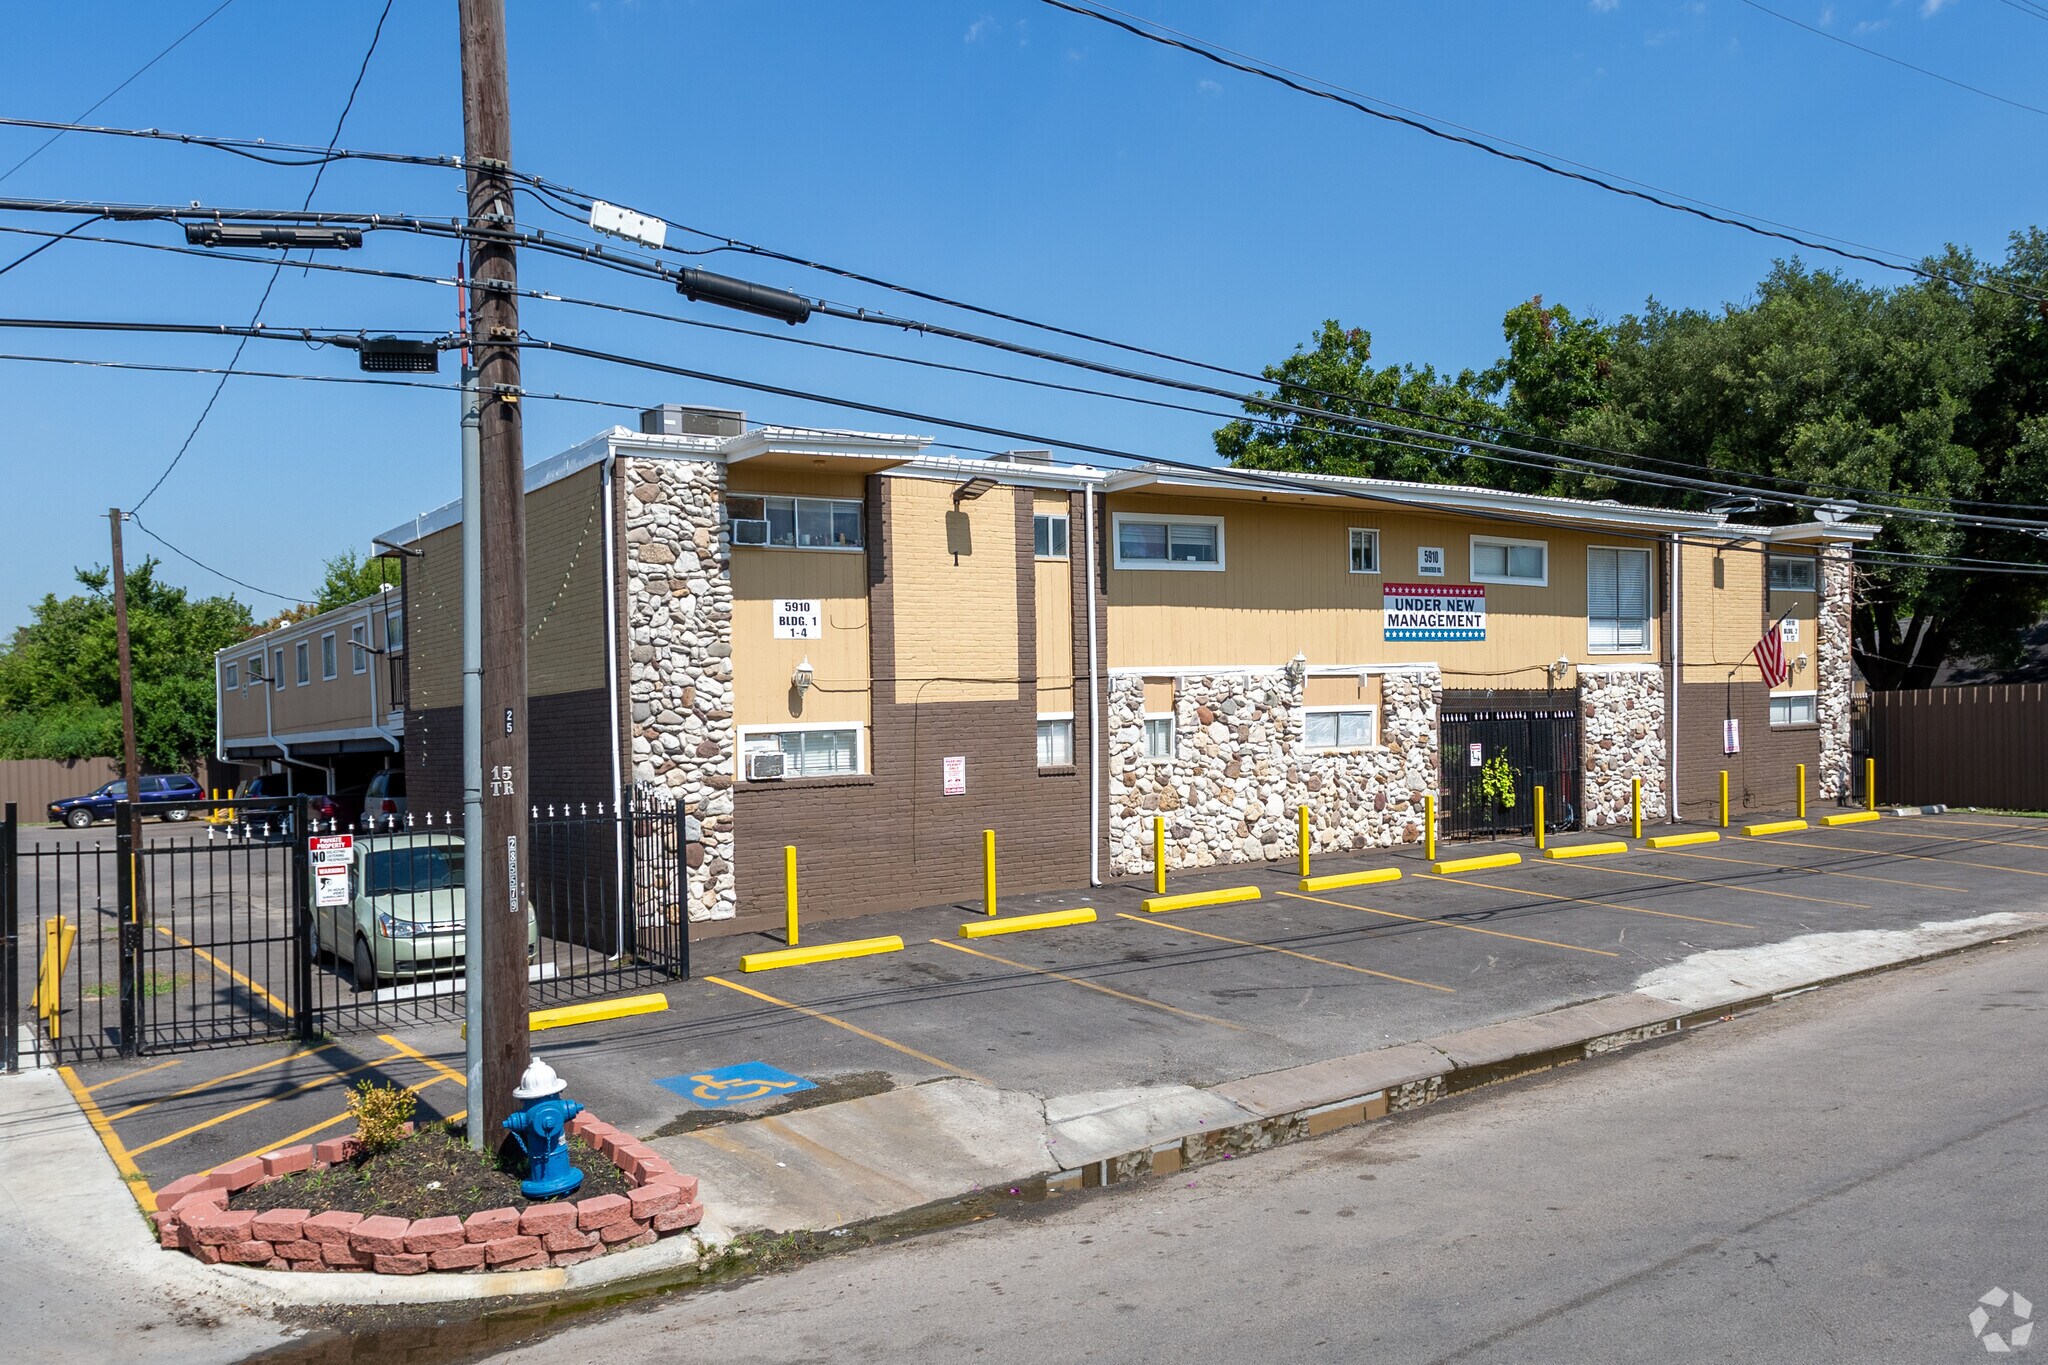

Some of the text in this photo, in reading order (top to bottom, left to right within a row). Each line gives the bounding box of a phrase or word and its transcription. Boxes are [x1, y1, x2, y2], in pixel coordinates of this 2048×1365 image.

[1424, 550, 1439, 564] 5910
[785, 601, 810, 612] 5910
[1395, 598, 1475, 612] UNDER NEW
[779, 616, 816, 626] BLDG. 1
[1388, 613, 1482, 627] MANAGEMENT
[790, 627, 807, 638] 1-4
[490, 765, 513, 781] 15
[490, 780, 515, 797] TR
[312, 851, 326, 863] NO
